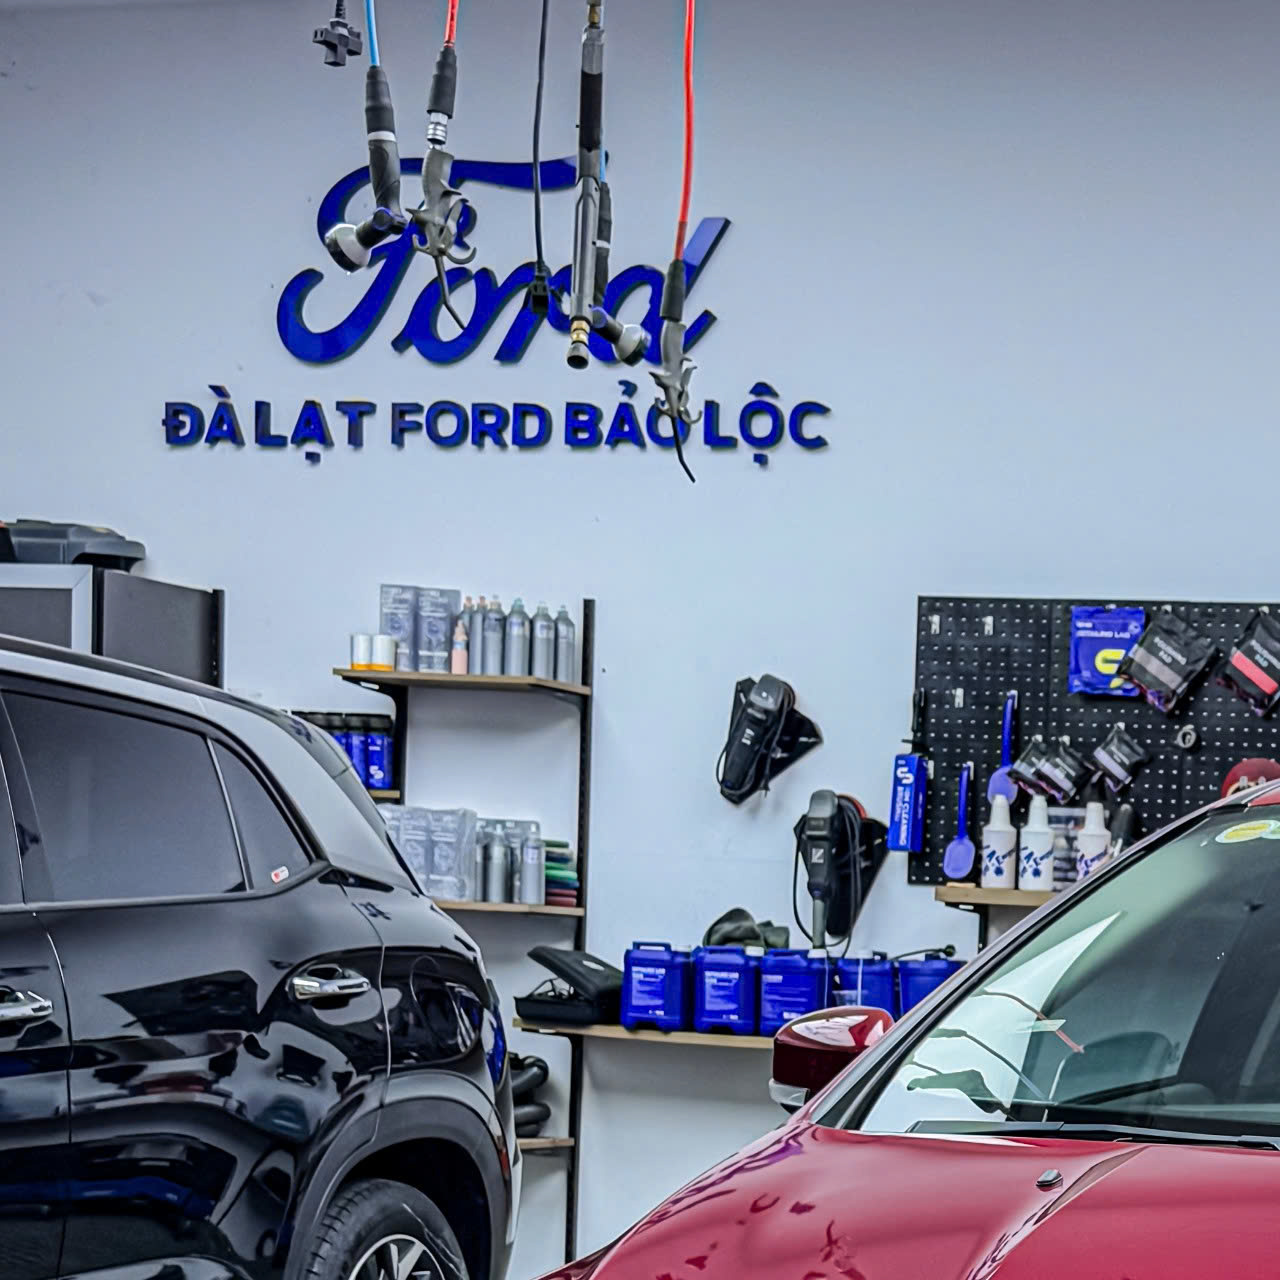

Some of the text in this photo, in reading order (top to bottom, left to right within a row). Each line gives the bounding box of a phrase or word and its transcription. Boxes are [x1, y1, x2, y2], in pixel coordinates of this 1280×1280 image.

[276, 155, 732, 366] Ford
[162, 384, 246, 448] ĐÀ
[254, 400, 377, 464] LẠT
[391, 400, 553, 449] FORD
[703, 381, 831, 466] LỘC
